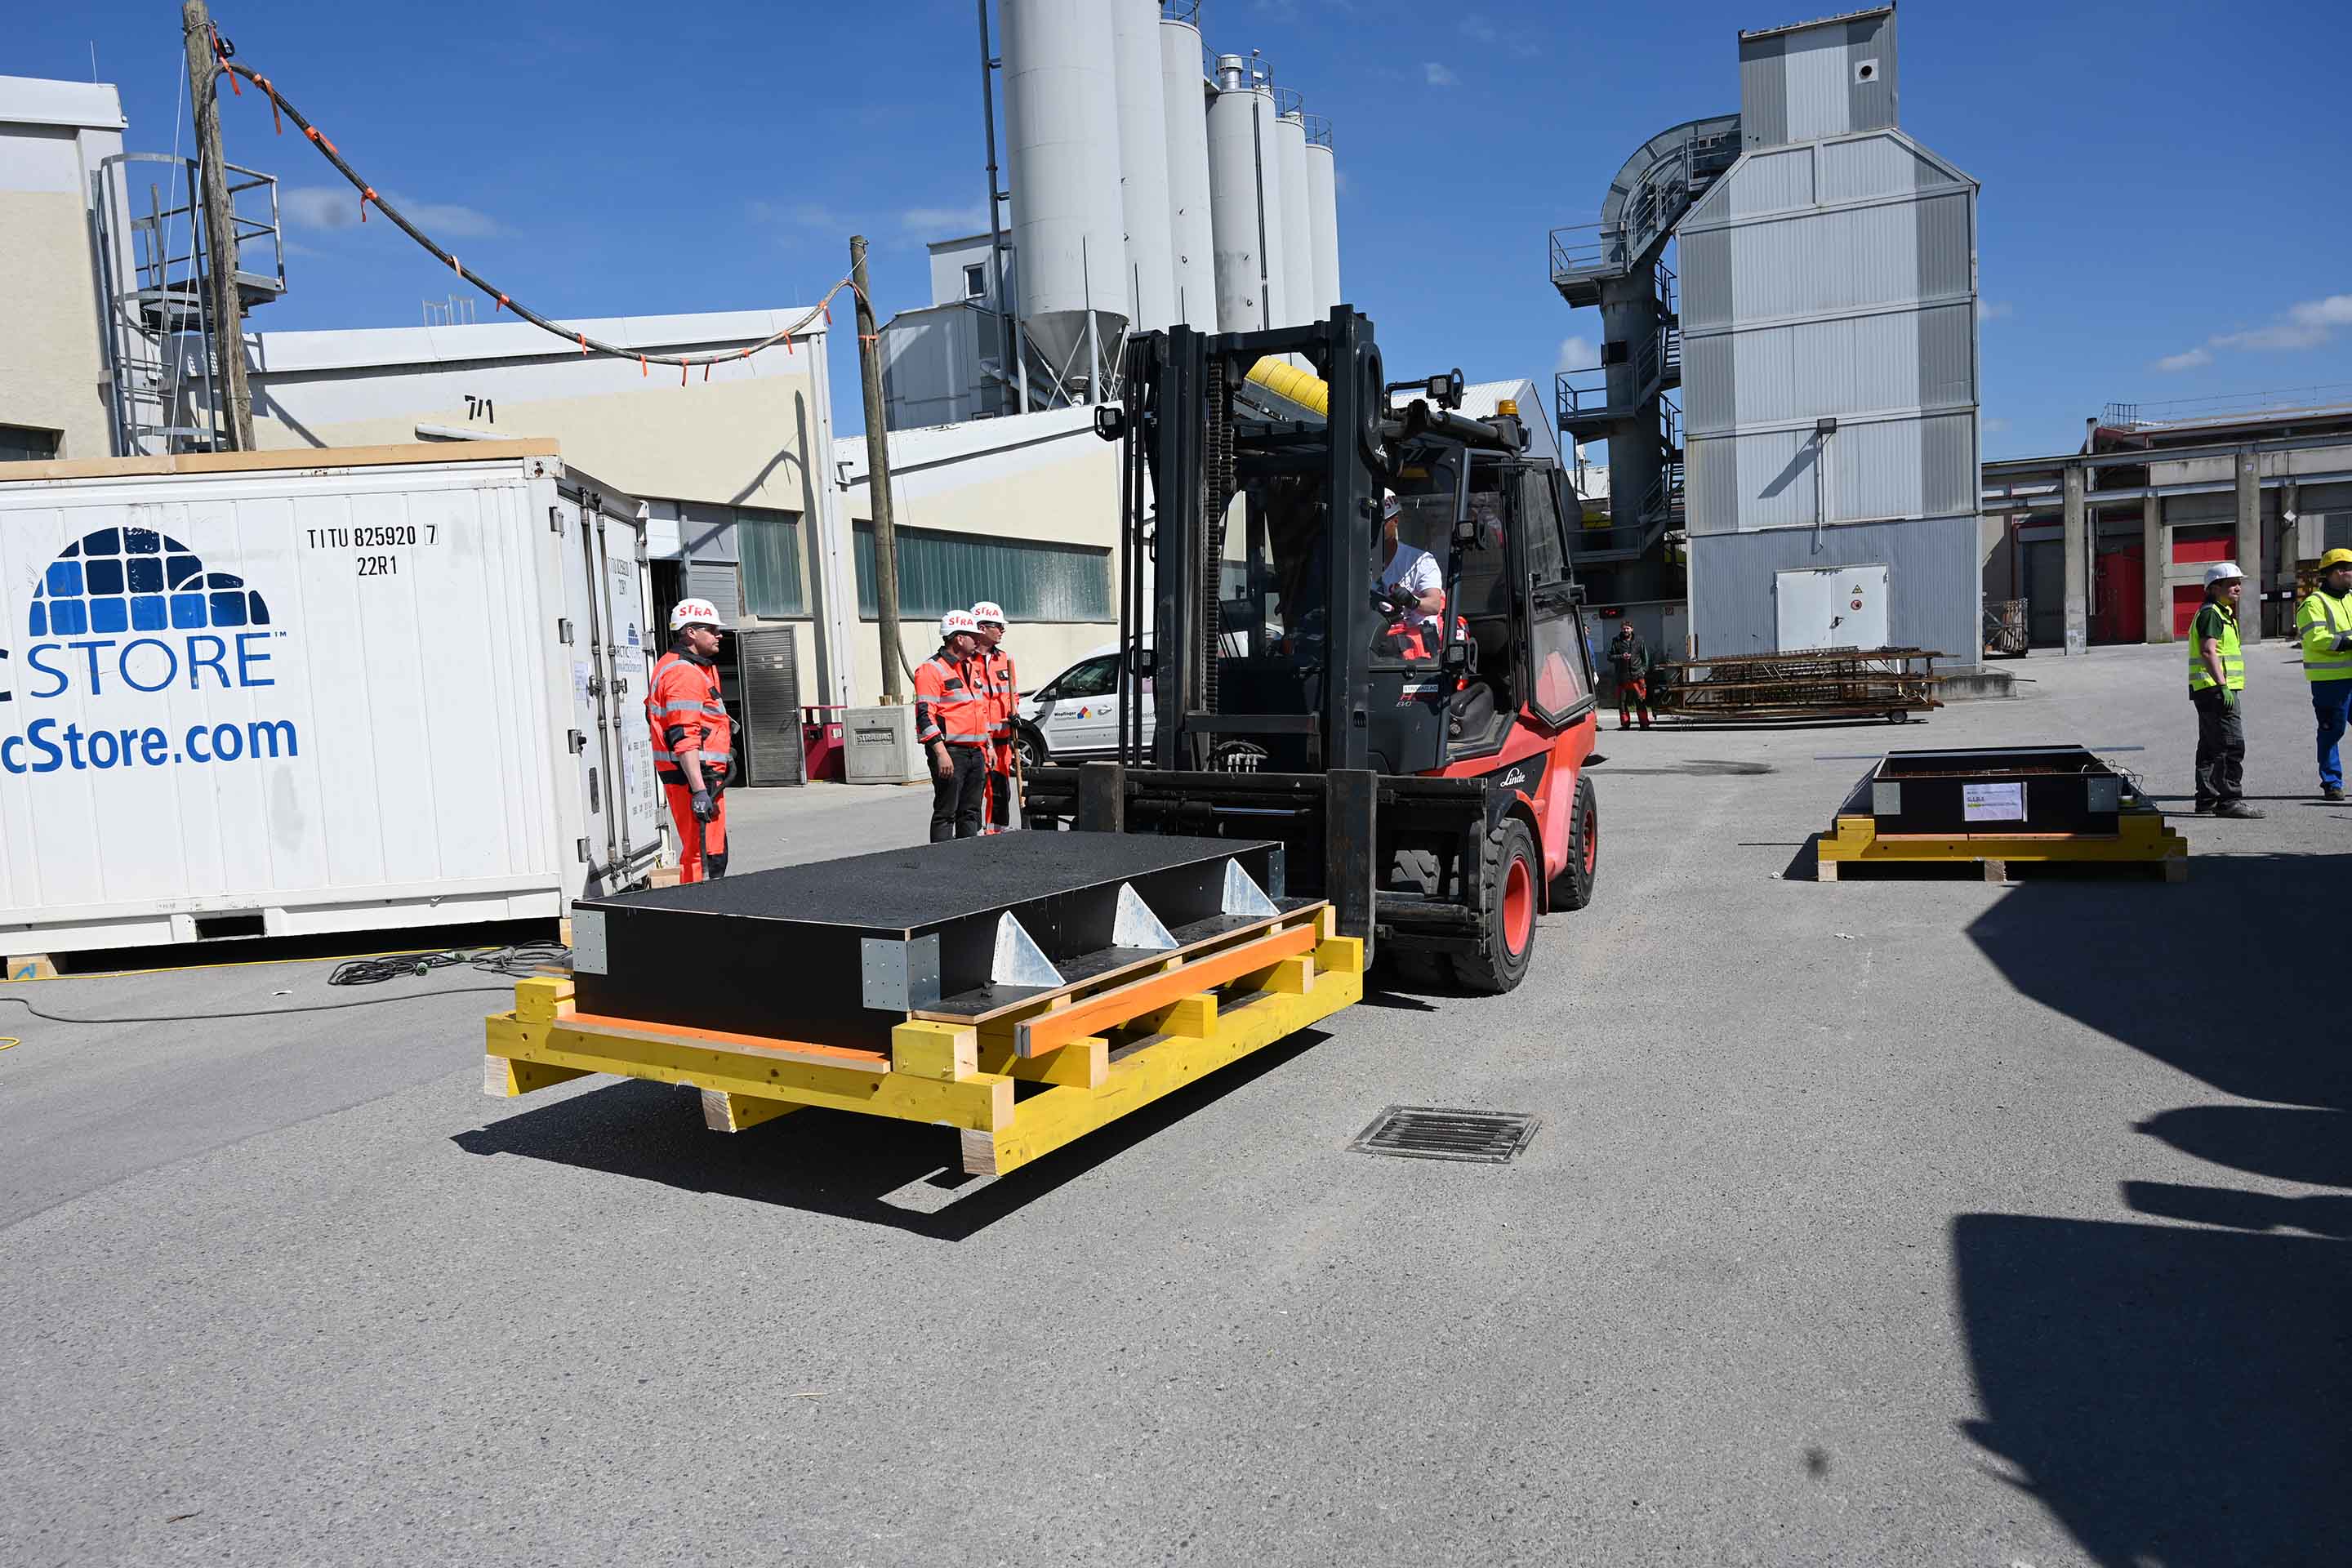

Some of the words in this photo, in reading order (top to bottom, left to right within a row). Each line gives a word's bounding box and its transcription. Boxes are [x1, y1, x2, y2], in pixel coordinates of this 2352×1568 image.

[307, 528, 349, 549] TITU
[354, 526, 416, 547] 825920
[425, 523, 437, 545] 7
[357, 555, 397, 576] 22R1
[1500, 768, 1526, 787] Linde
